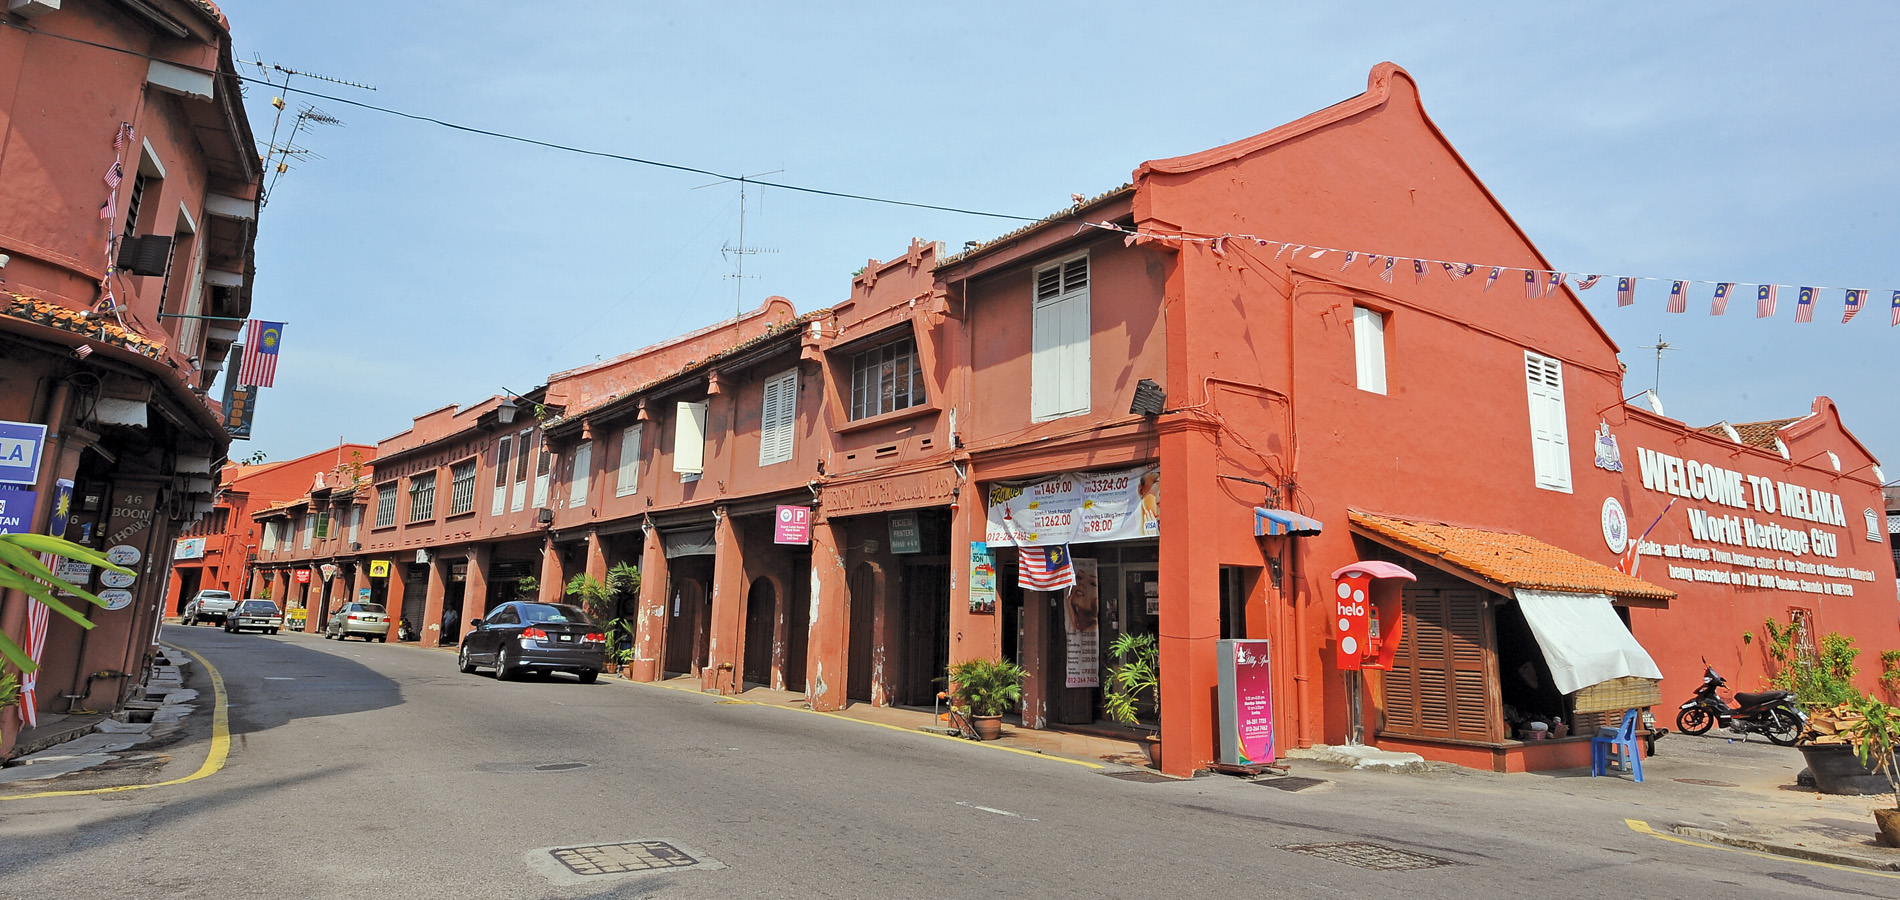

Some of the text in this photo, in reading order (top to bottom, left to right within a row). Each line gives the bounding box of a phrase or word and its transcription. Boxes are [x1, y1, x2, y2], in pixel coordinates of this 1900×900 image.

[124, 495, 143, 505] 46
[1637, 446, 1847, 527] WELCOME TO MELAKA
[111, 507, 151, 518] BOON
[796, 510, 804, 522] P
[1687, 508, 1837, 558] World Heritage City
[1628, 539, 1662, 556] elaka
[1664, 544, 1680, 558] and
[1681, 544, 1710, 562] George
[1776, 557, 1784, 571] of
[1784, 560, 1796, 572] the
[1796, 561, 1816, 574] Straits
[1816, 563, 1824, 575] of
[1824, 564, 1847, 578] Malacca
[1668, 564, 1693, 581] being
[1693, 568, 1730, 584] inscribed
[1731, 572, 1741, 585] on
[1759, 574, 1775, 588] 2008
[1801, 579, 1823, 594] Canada
[1823, 582, 1832, 595] by
[1832, 583, 1853, 597] UNESCO
